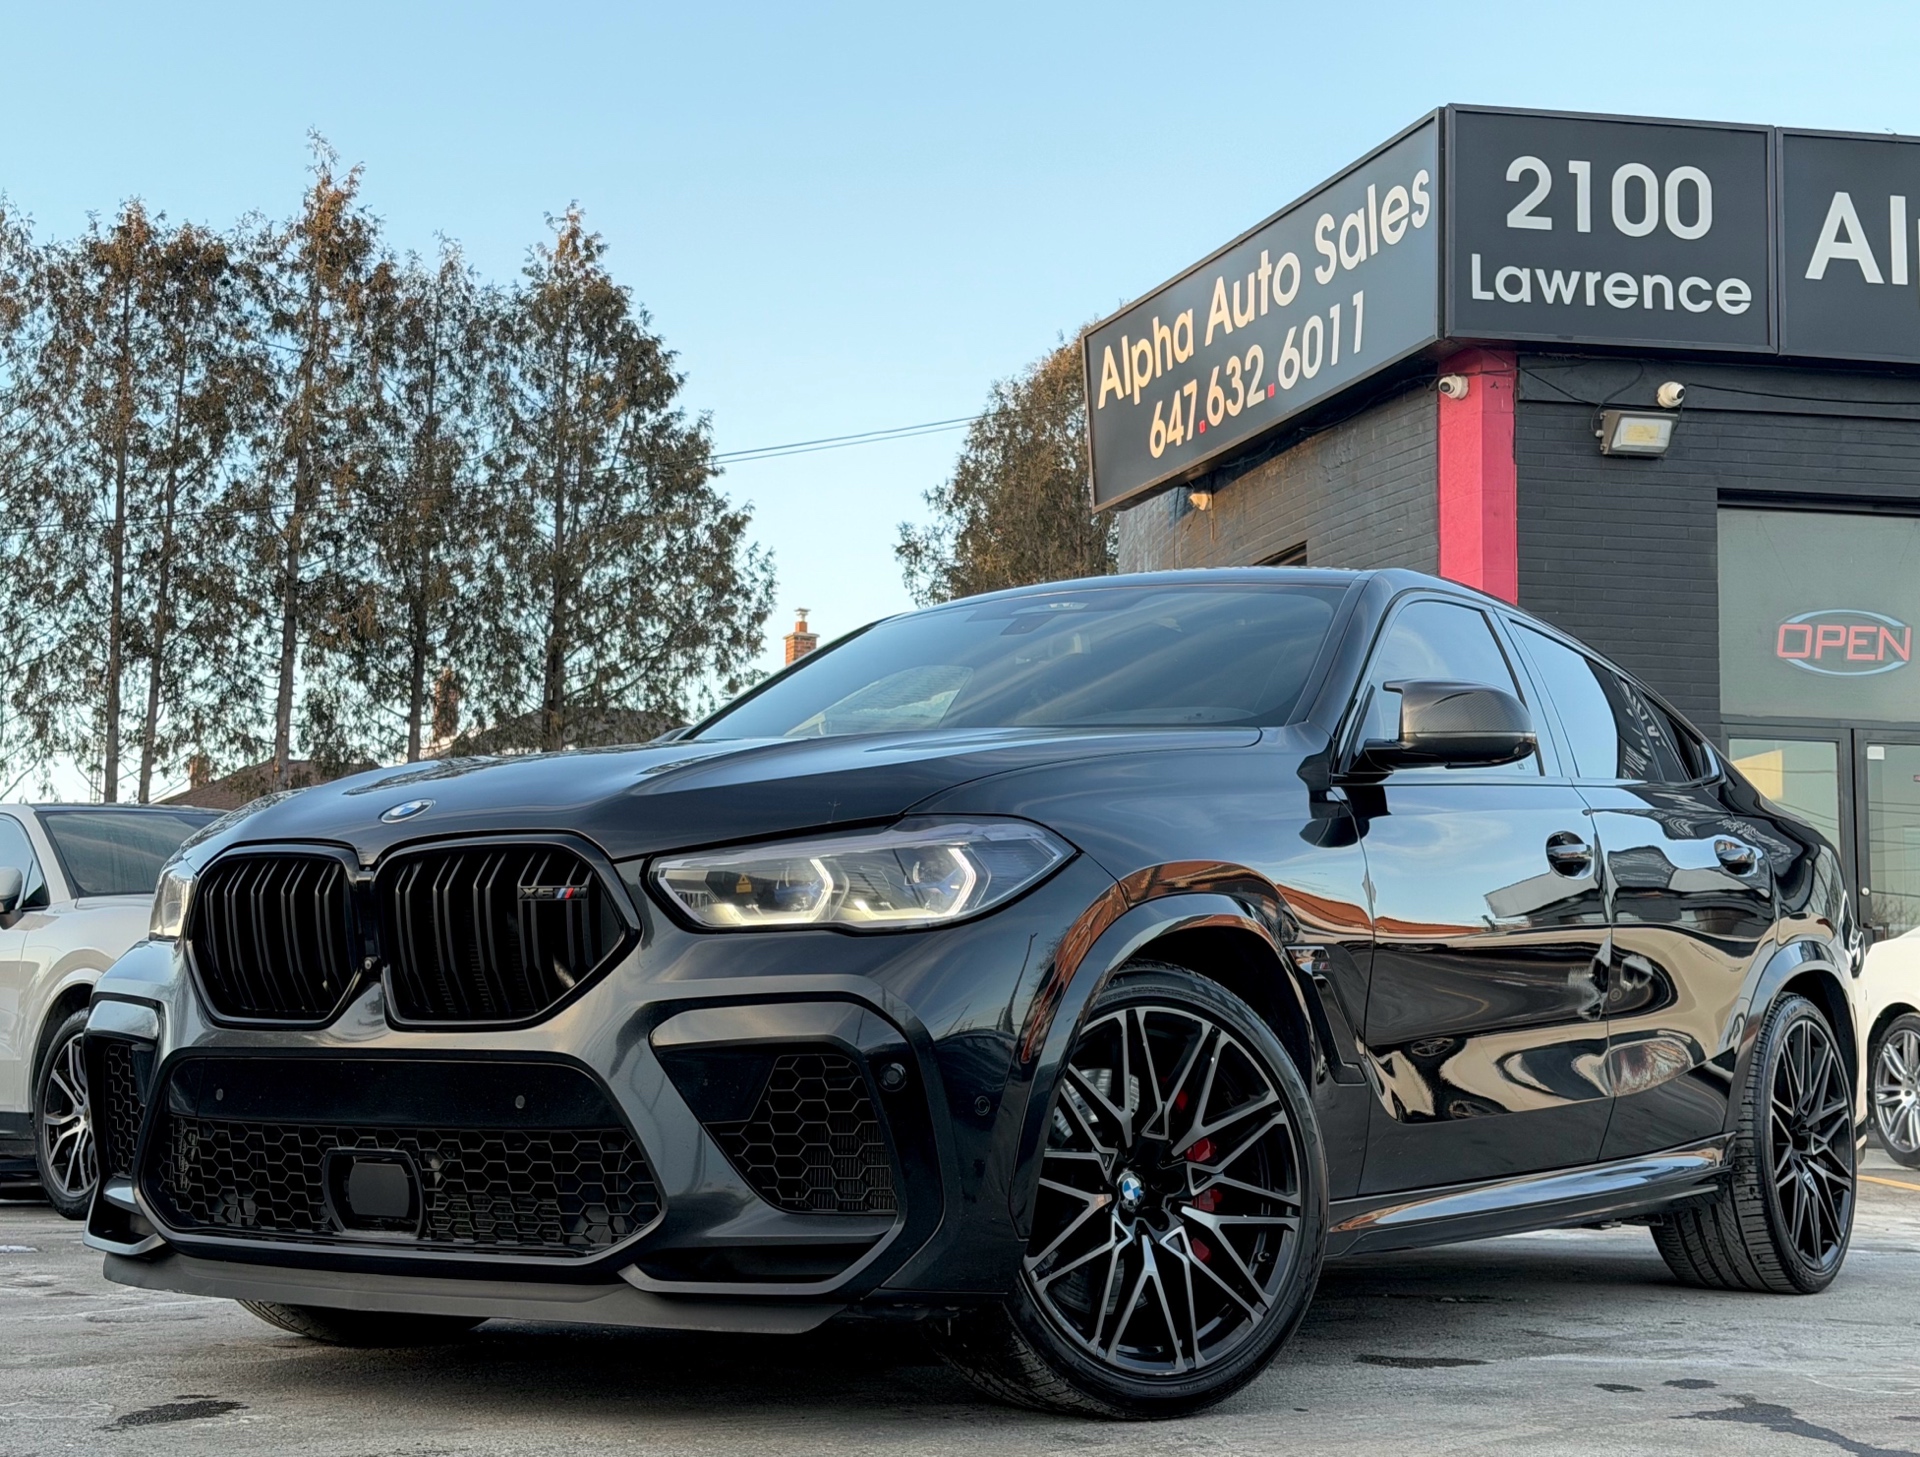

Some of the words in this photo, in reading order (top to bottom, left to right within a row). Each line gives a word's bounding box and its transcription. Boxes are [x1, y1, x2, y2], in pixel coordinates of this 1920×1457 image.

[1505, 155, 1713, 240] 2100
[1804, 191, 1920, 286] Al
[1097, 308, 1194, 409] Alpha
[1204, 249, 1301, 347] Auto
[1314, 169, 1430, 285] Sales
[1471, 253, 1752, 315] Lawrence
[1149, 290, 1364, 458] 647.632.6011
[1776, 623, 1911, 661] OPEN
